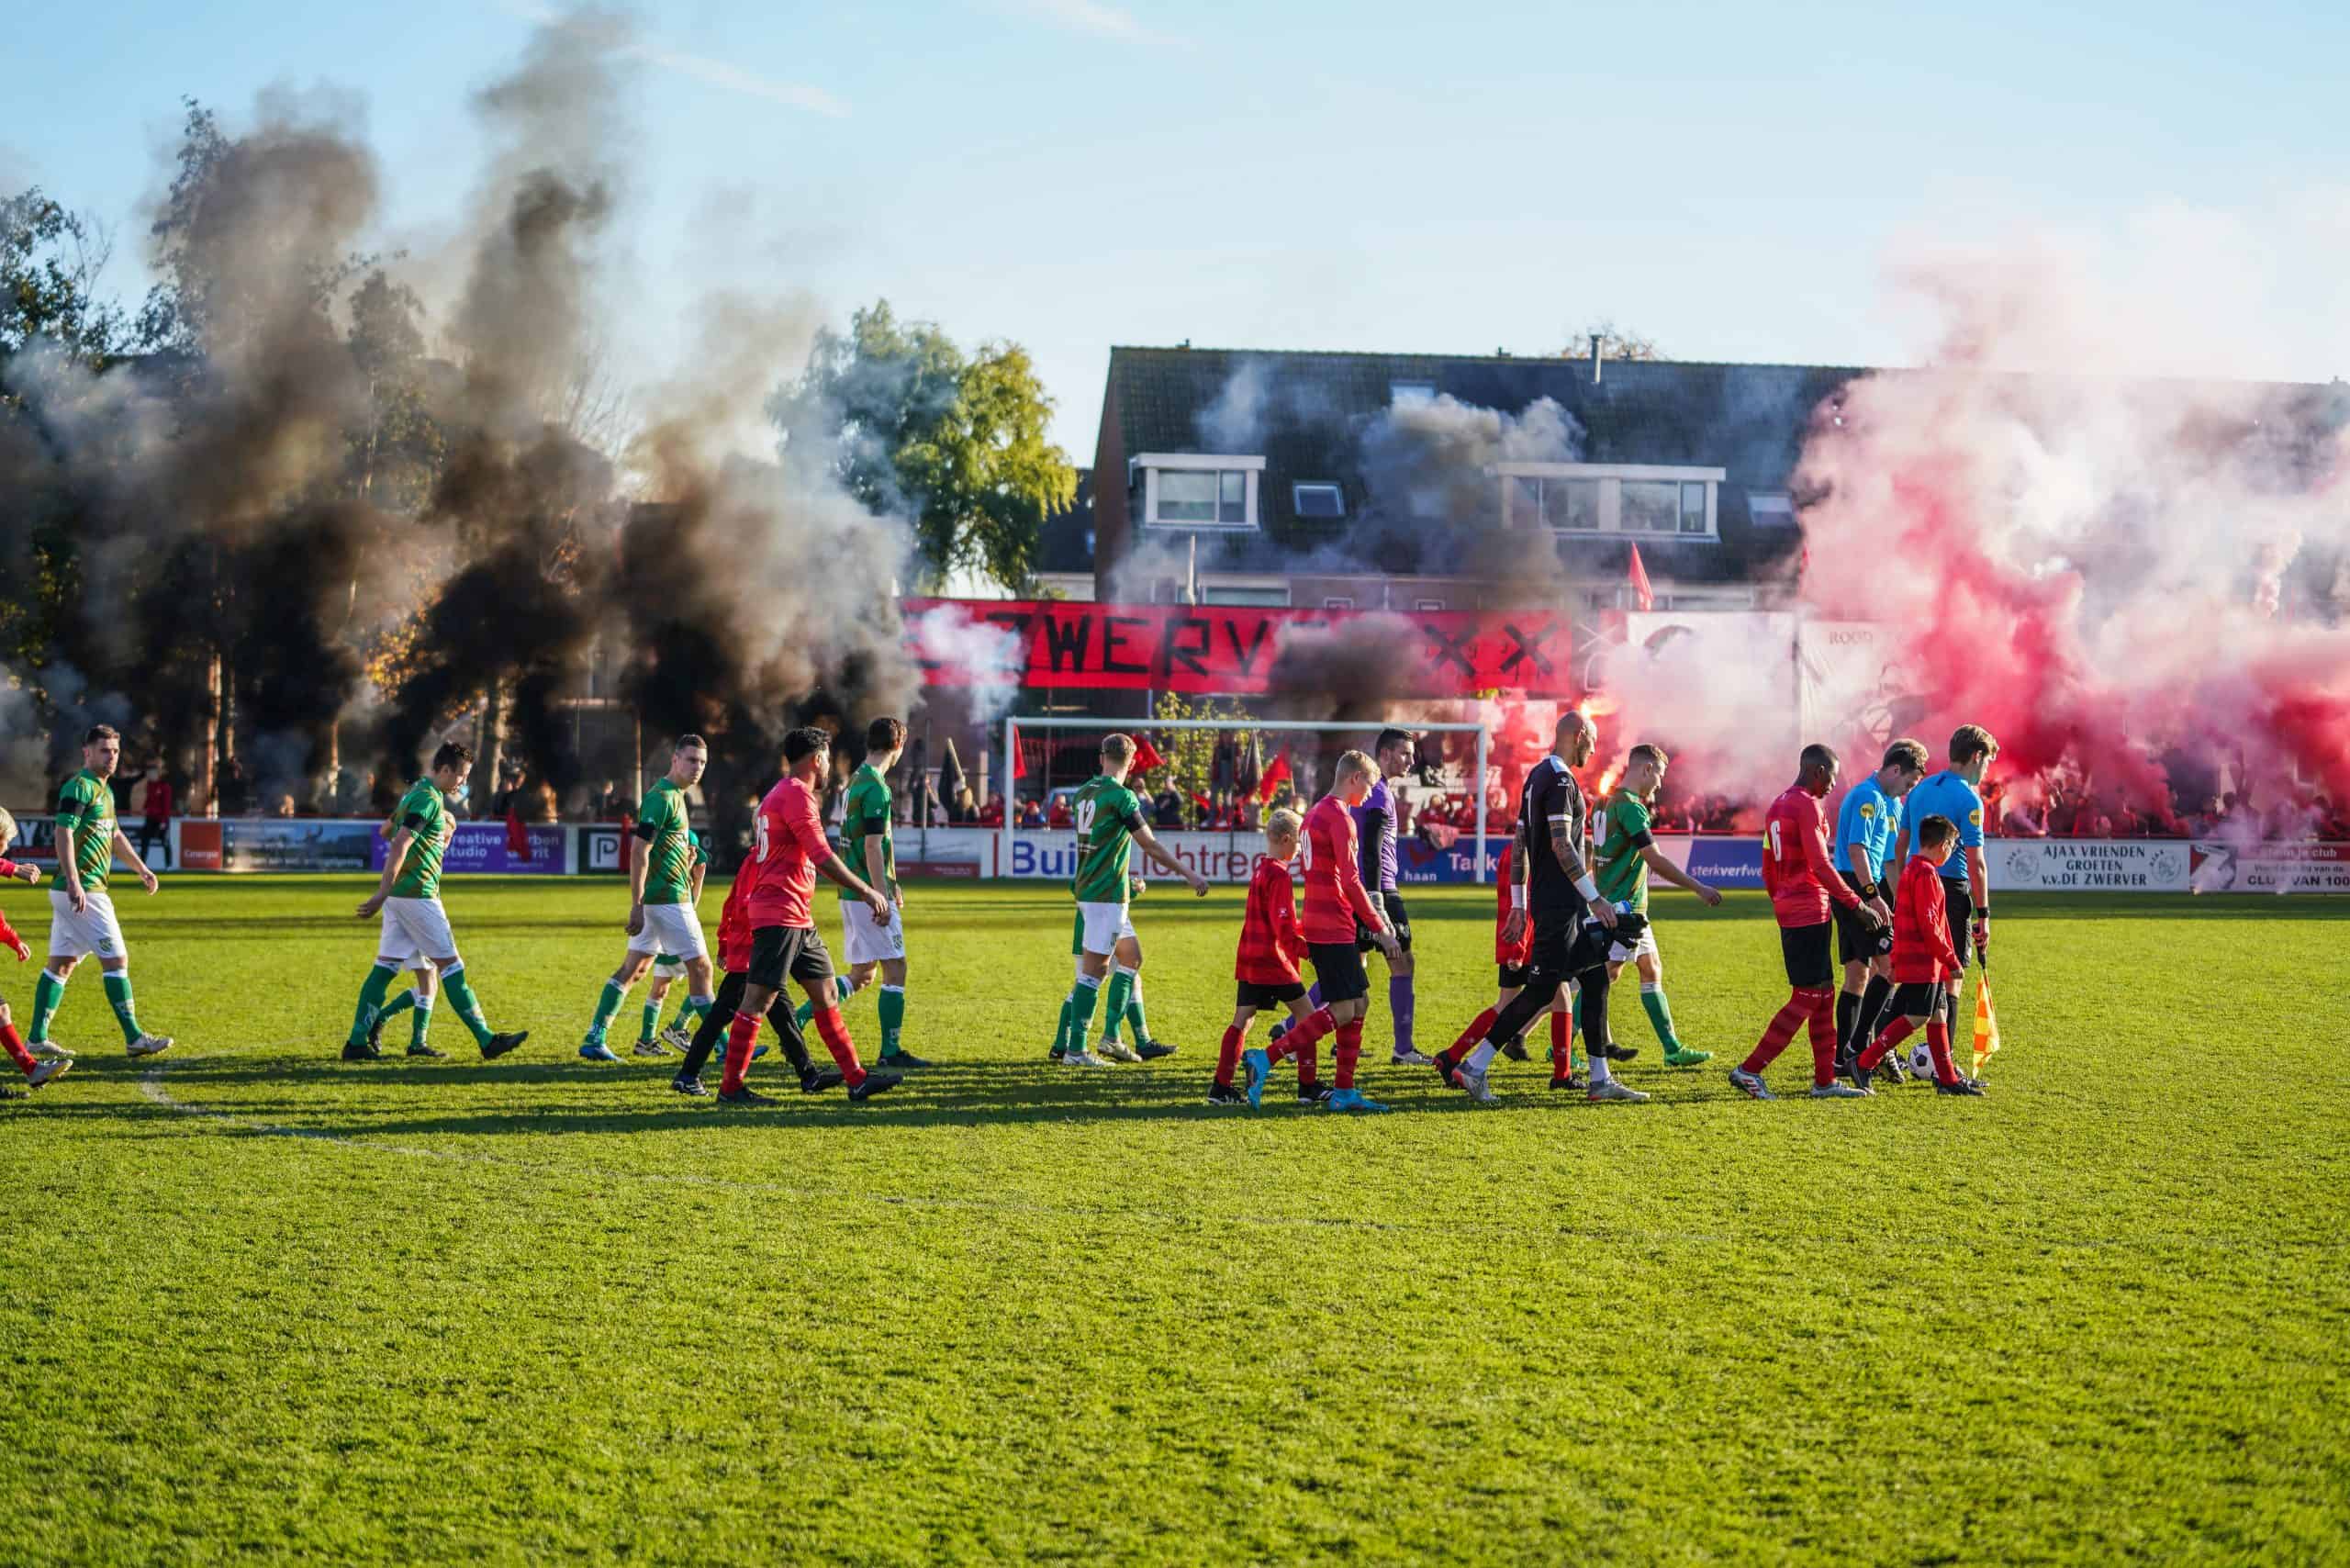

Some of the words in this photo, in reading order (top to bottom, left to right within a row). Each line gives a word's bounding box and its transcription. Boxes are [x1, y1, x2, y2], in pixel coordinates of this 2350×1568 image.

[2043, 845, 2076, 859] AJAX
[2081, 845, 2146, 858] VRIENDEN
[2065, 859, 2123, 871] GROETEN
[2084, 873, 2147, 886] ZWERVER
